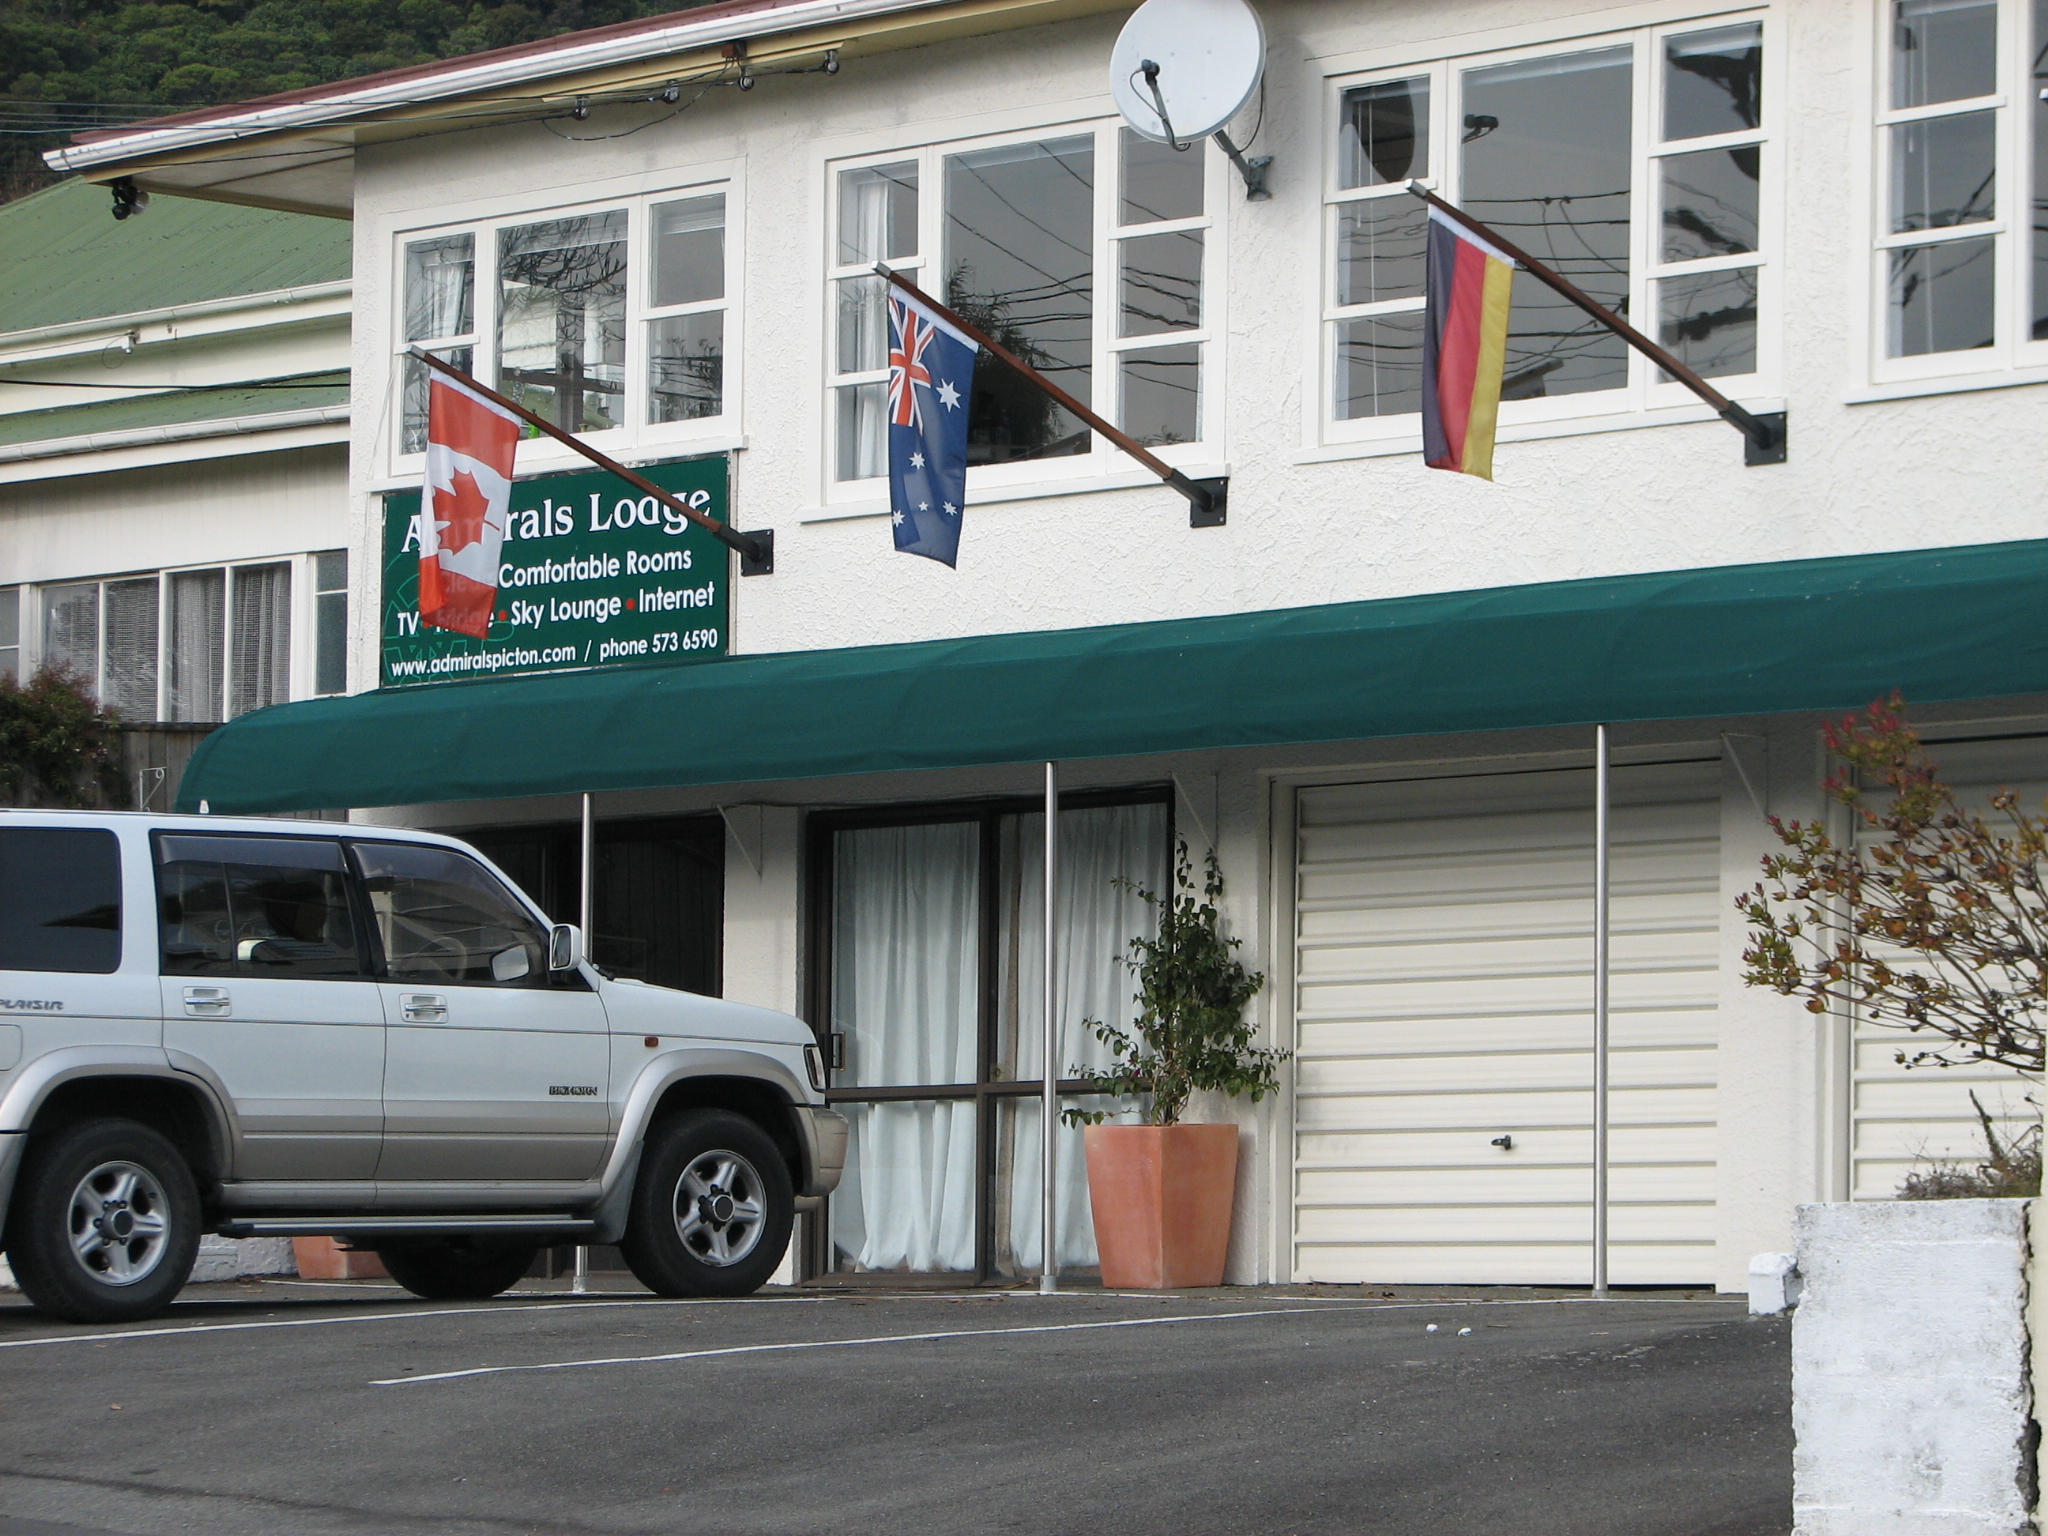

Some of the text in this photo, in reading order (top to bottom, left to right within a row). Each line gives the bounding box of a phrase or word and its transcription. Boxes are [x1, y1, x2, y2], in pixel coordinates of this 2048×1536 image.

[400, 489, 711, 553] Arals Lodge
[499, 553, 620, 588] Comfortable
[626, 550, 692, 575] Rooms
[396, 611, 419, 636] TV
[510, 599, 544, 630] Sky
[551, 596, 622, 624] Lounge
[639, 581, 715, 613] Internet
[391, 645, 576, 677] www.admiralspicton.com
[599, 637, 648, 663] phone
[652, 631, 679, 653] 573
[682, 628, 718, 650] 6590
